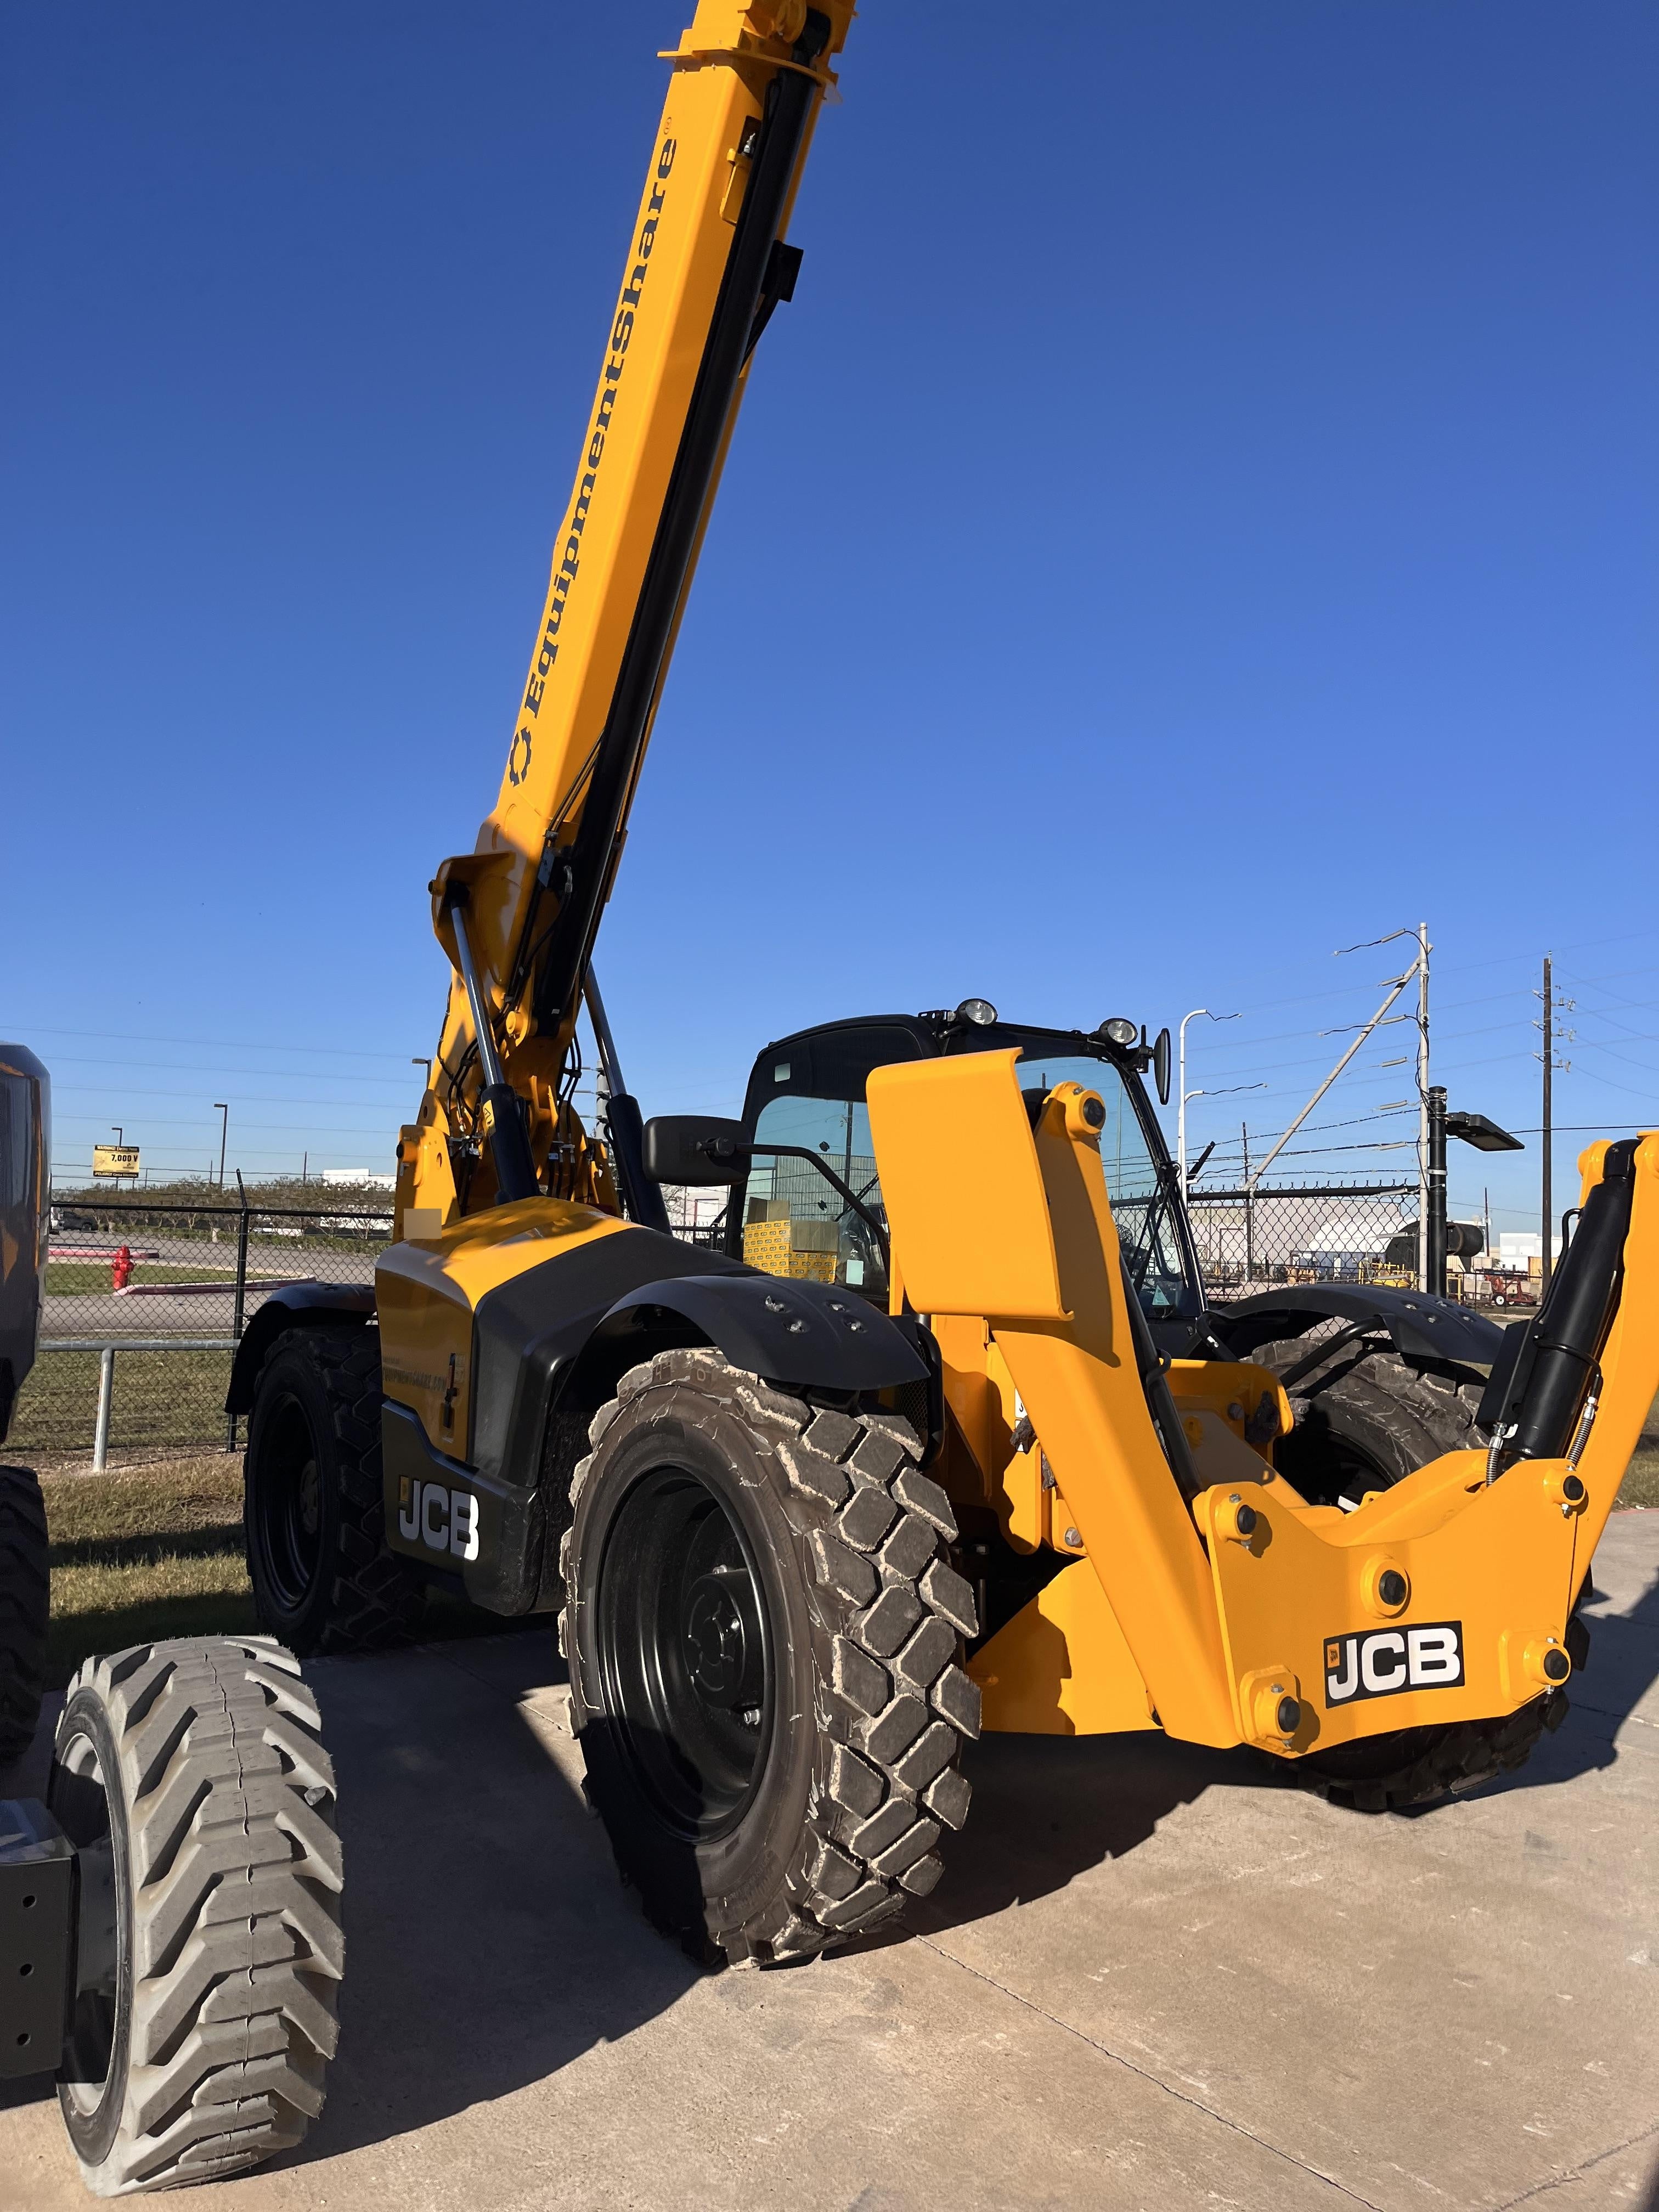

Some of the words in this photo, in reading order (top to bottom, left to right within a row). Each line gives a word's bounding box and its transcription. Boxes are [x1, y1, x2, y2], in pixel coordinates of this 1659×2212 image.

[524, 138, 677, 719] EquipmentShare
[399, 1480, 479, 1561] JCB
[1328, 1628, 1460, 1700] JCB
